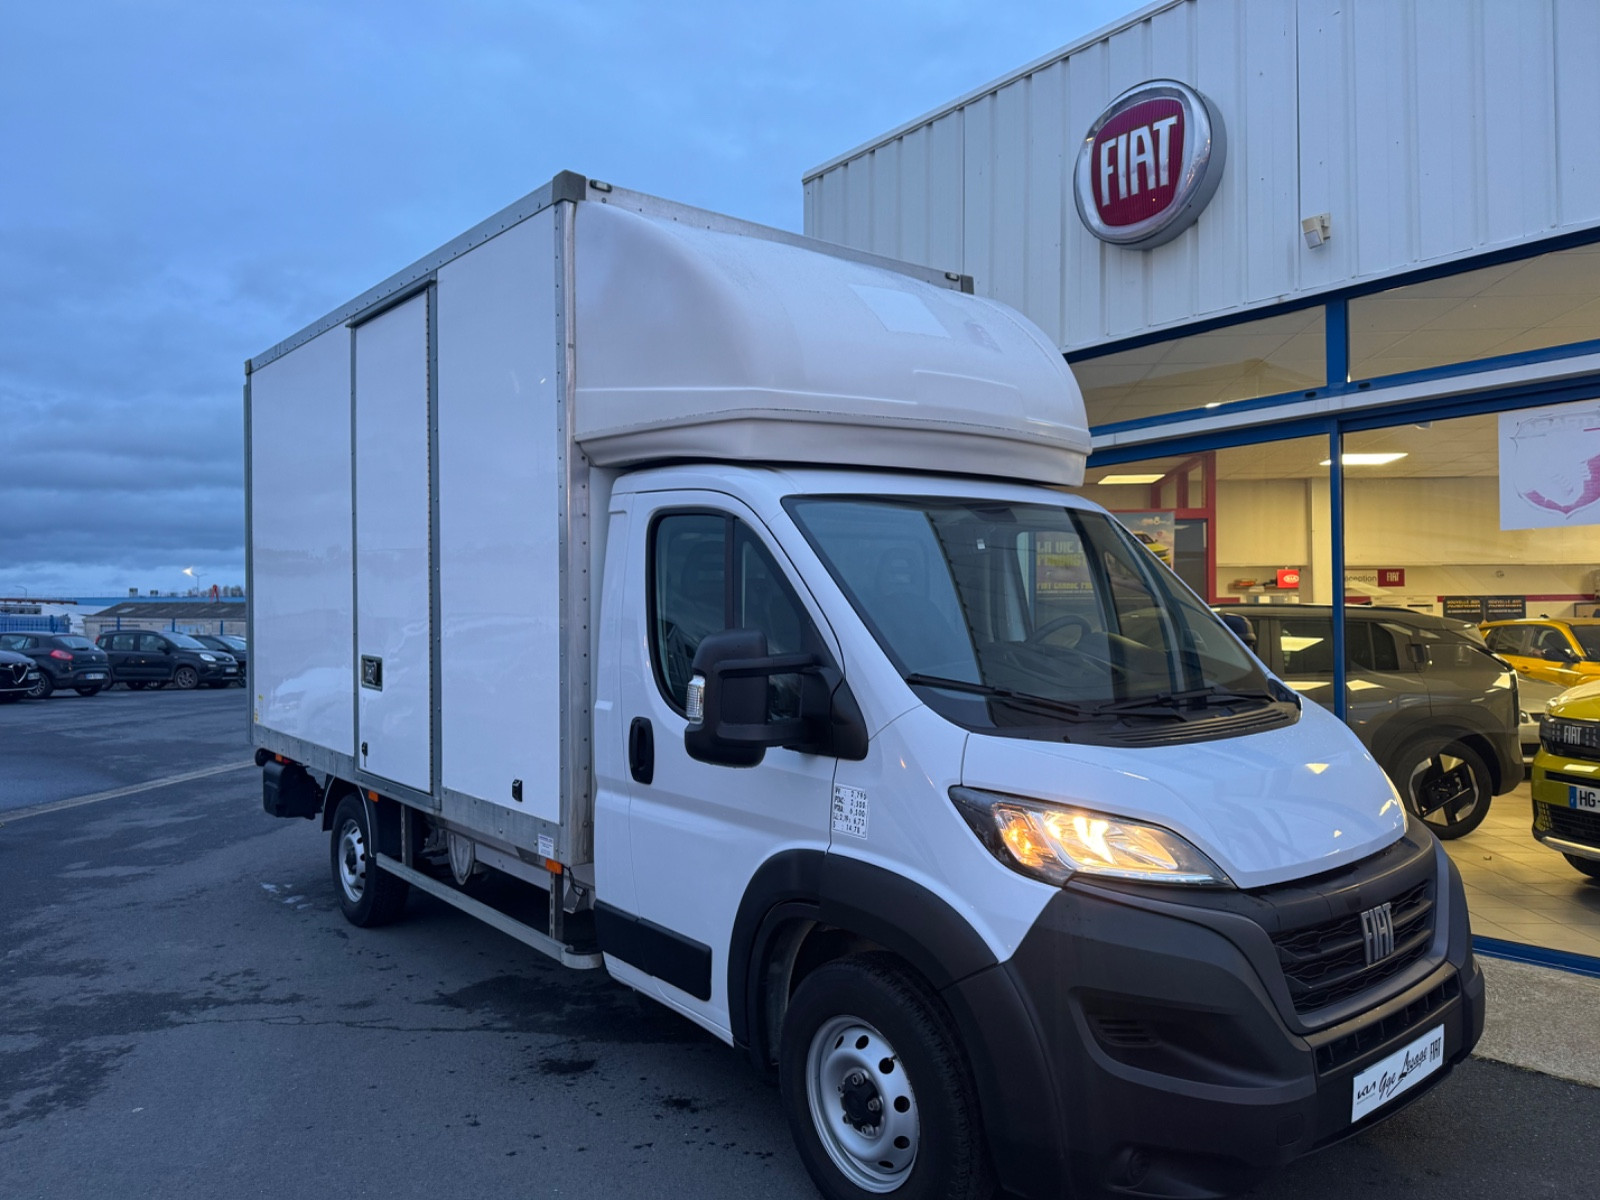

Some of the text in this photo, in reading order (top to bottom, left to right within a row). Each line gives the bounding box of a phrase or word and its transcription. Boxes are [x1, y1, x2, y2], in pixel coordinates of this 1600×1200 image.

[1101, 115, 1178, 207] FIAT
[1386, 571, 1400, 582] FIAT
[1563, 725, 1582, 745] FIAT
[1361, 902, 1395, 967] FIAT
[1429, 1036, 1442, 1063] FIAT
